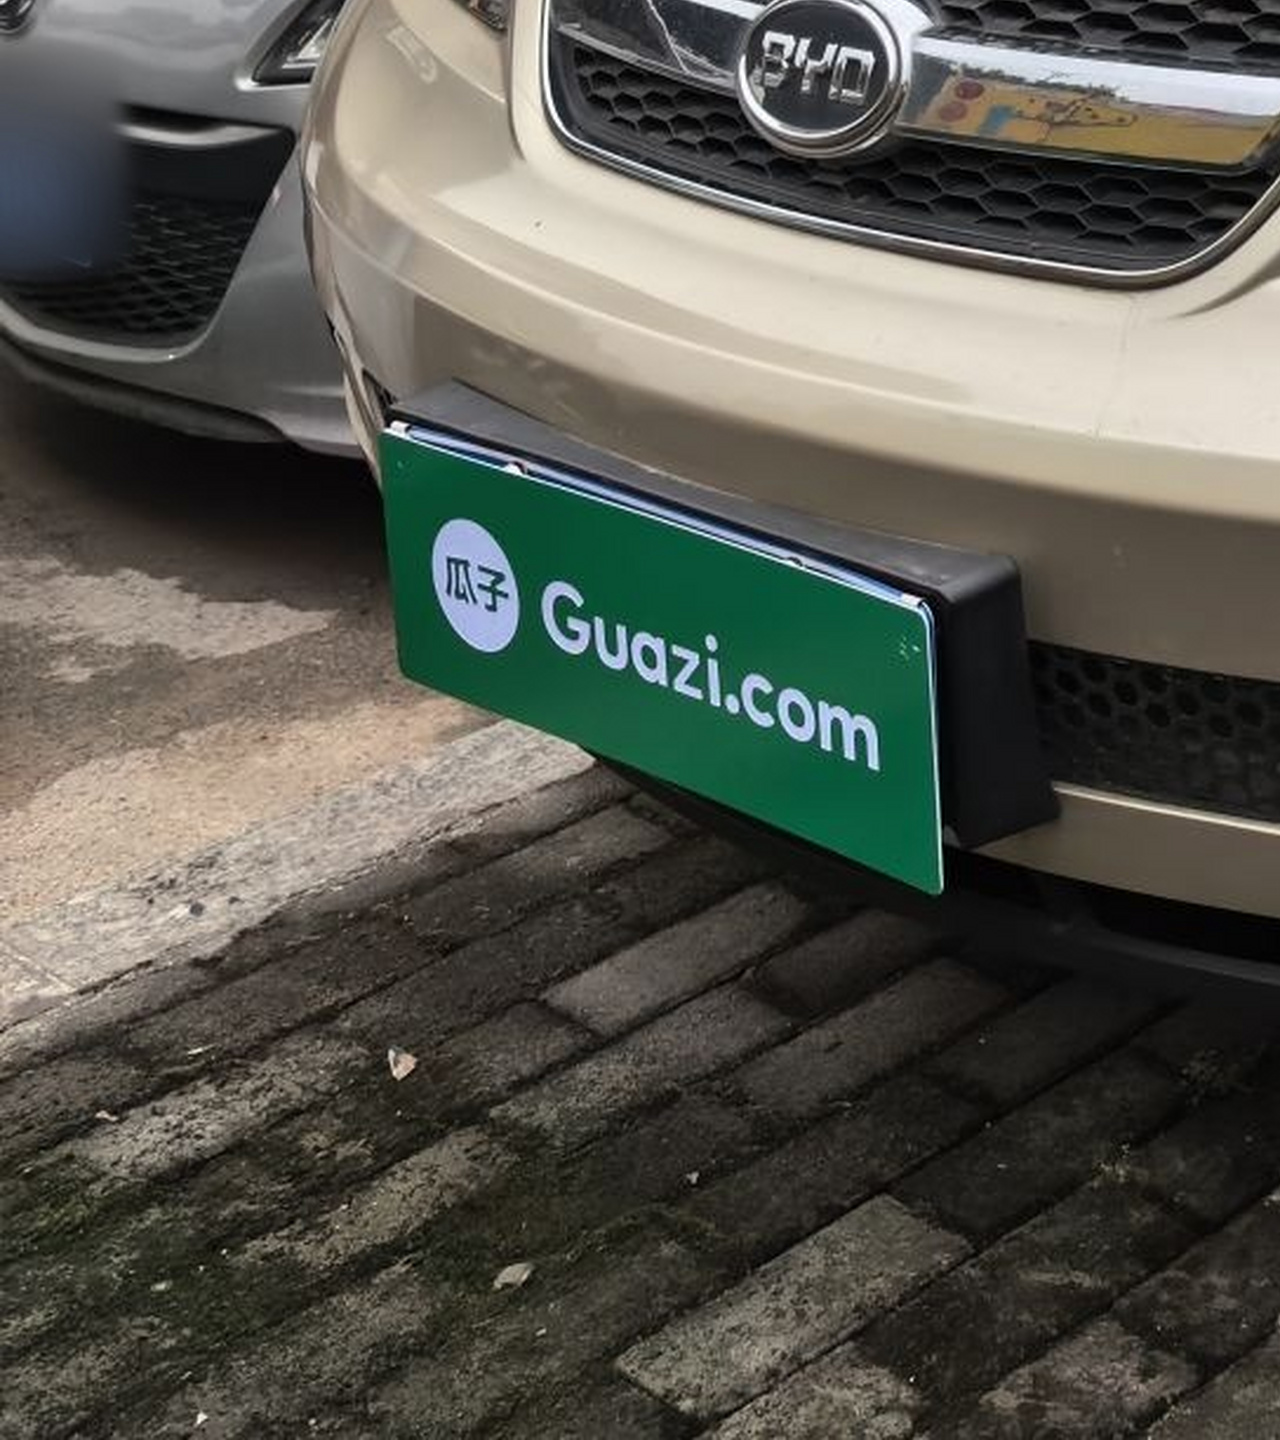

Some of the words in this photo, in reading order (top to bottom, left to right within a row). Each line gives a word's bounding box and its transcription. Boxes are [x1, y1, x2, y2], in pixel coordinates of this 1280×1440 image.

[761, 30, 875, 106] BYD
[445, 556, 510, 613] 瓜子
[540, 580, 881, 772] Guazi.com
